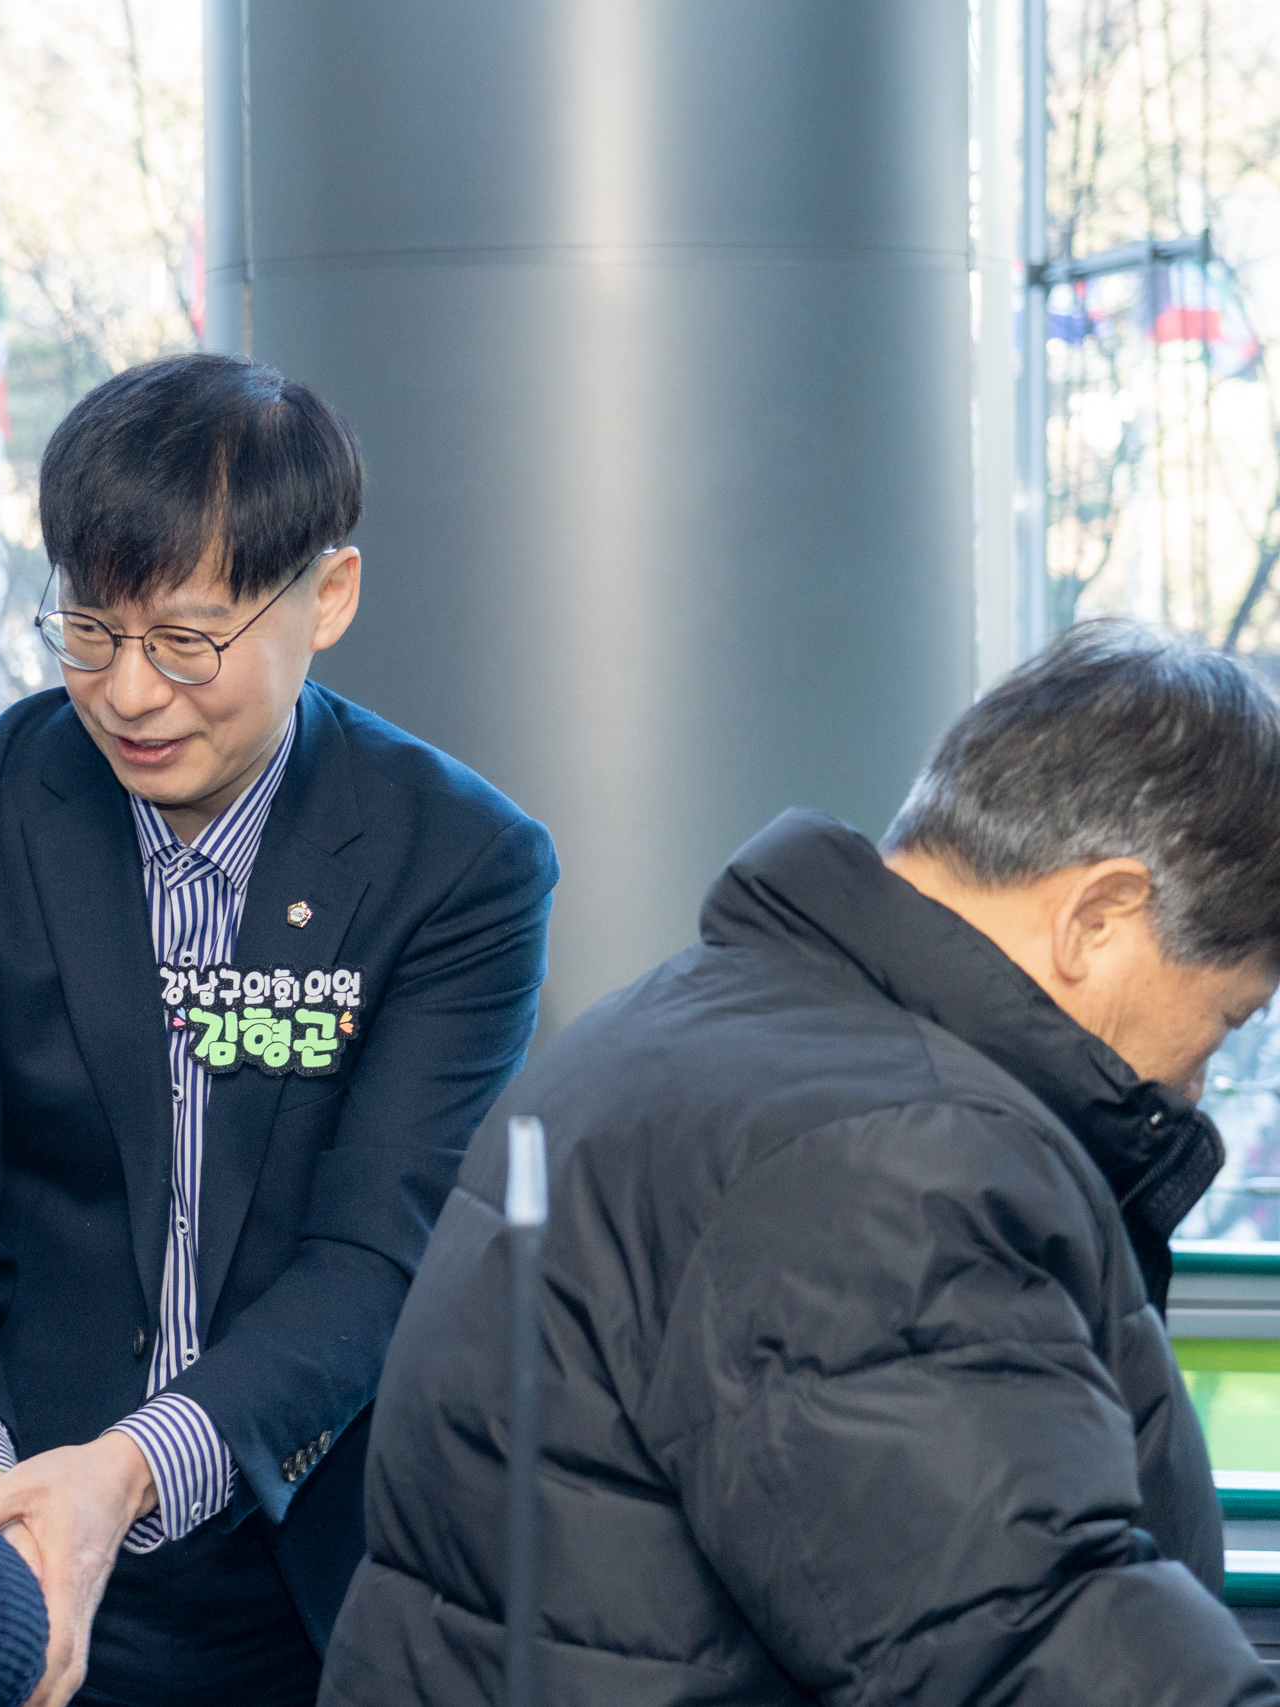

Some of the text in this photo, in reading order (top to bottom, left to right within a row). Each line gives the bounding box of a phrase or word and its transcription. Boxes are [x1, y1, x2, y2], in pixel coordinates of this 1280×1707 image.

[159, 967, 361, 1008] 강남구의회 의원
[189, 1006, 338, 1068] 김형곤
